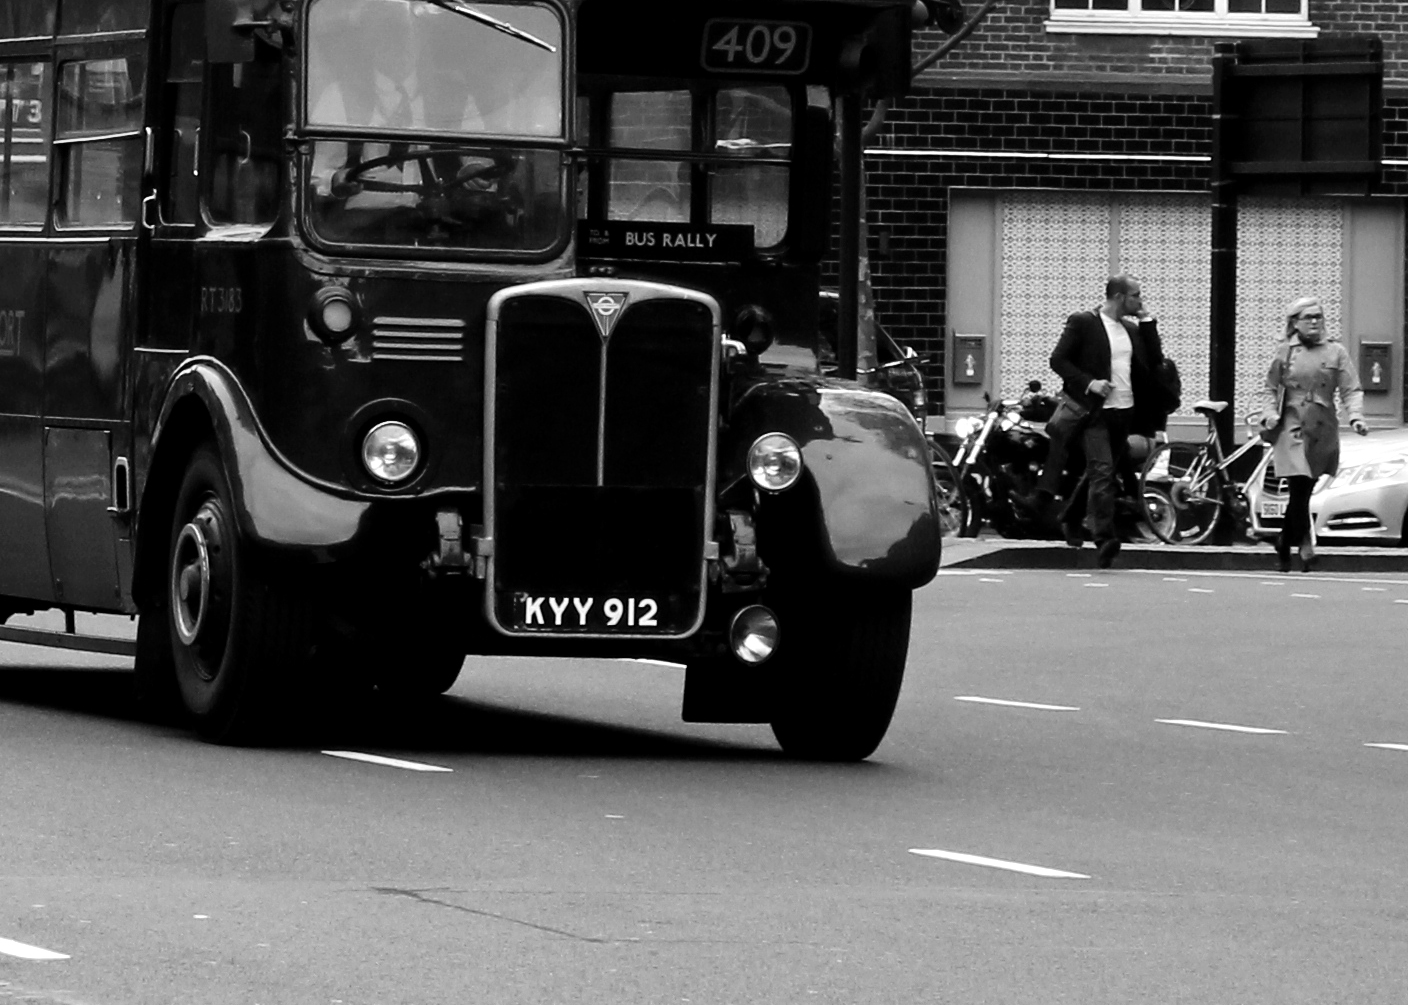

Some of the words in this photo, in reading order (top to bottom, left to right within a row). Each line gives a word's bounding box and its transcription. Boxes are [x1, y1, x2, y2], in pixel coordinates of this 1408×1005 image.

[712, 25, 797, 65] 409
[625, 231, 656, 246] BUS
[663, 232, 718, 248] RALLY
[525, 597, 594, 626] KYY
[603, 598, 658, 626] 912
